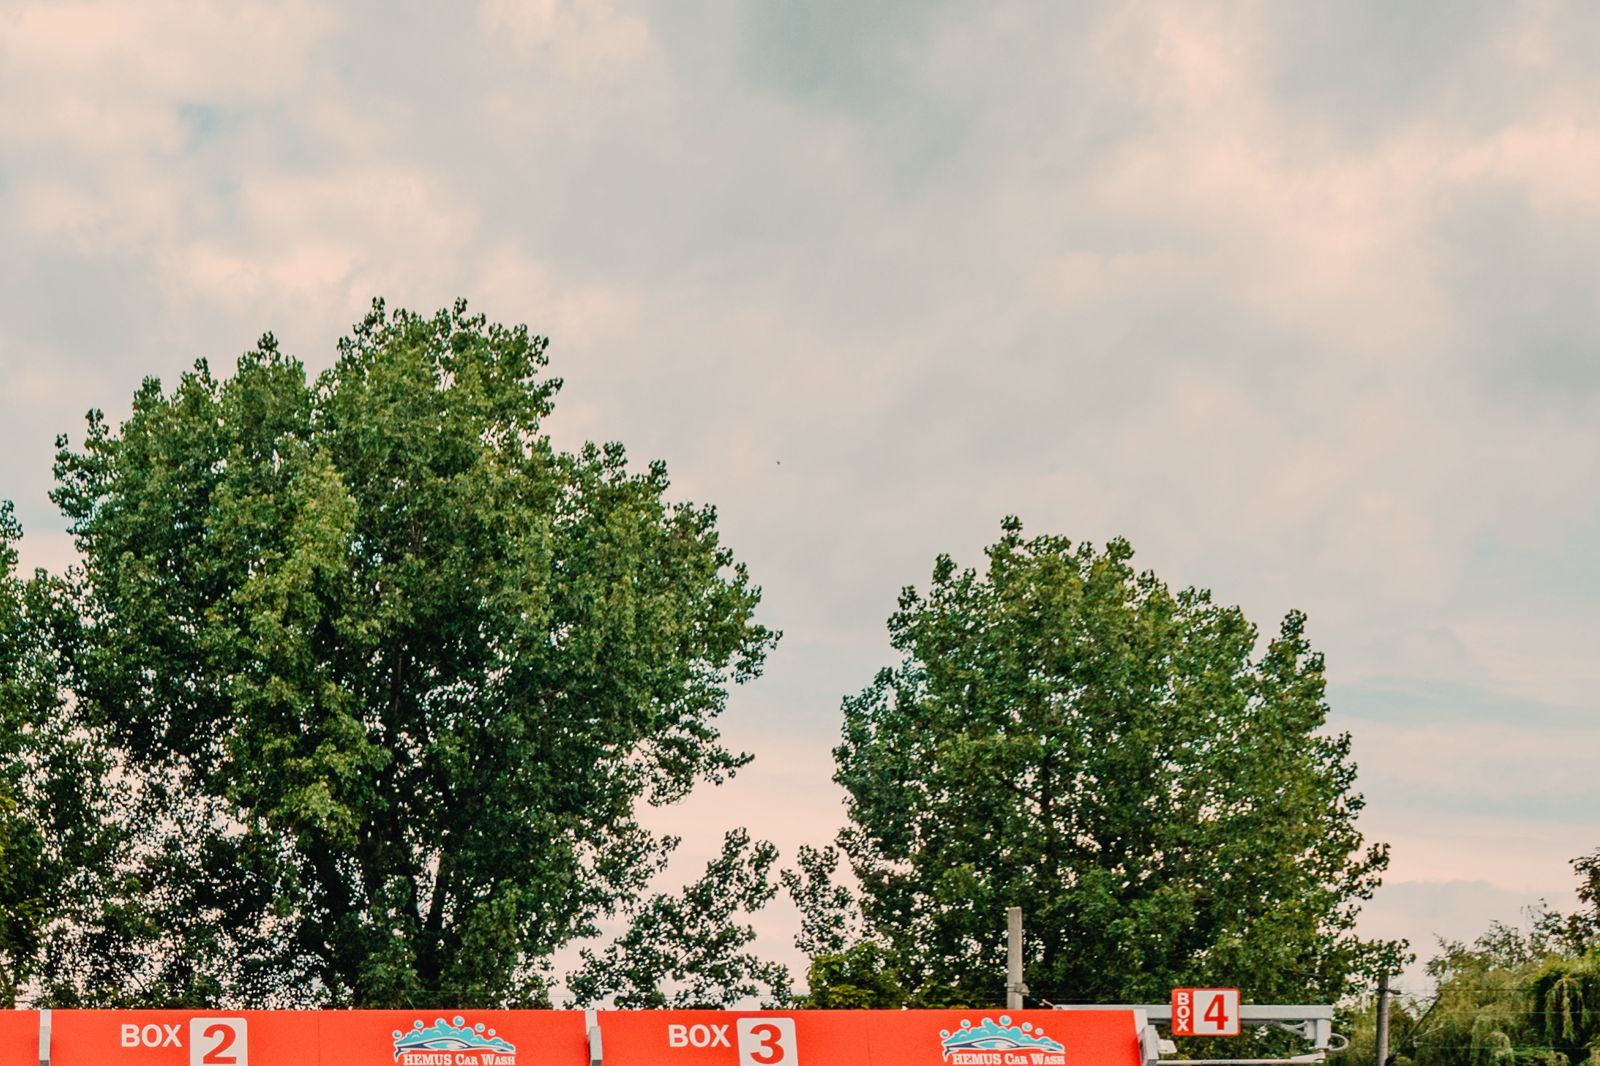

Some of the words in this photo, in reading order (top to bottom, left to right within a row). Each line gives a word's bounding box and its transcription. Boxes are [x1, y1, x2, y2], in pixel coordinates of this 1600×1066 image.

[1176, 992, 1190, 1032] BOX
[1203, 994, 1229, 1030] 4
[120, 1023, 182, 1048] BOX
[202, 1023, 238, 1065] 2
[403, 1054, 453, 1066] HEMUS
[668, 1023, 729, 1048] BOX
[749, 1023, 786, 1066] 3
[952, 1053, 1002, 1065] HEMUS
